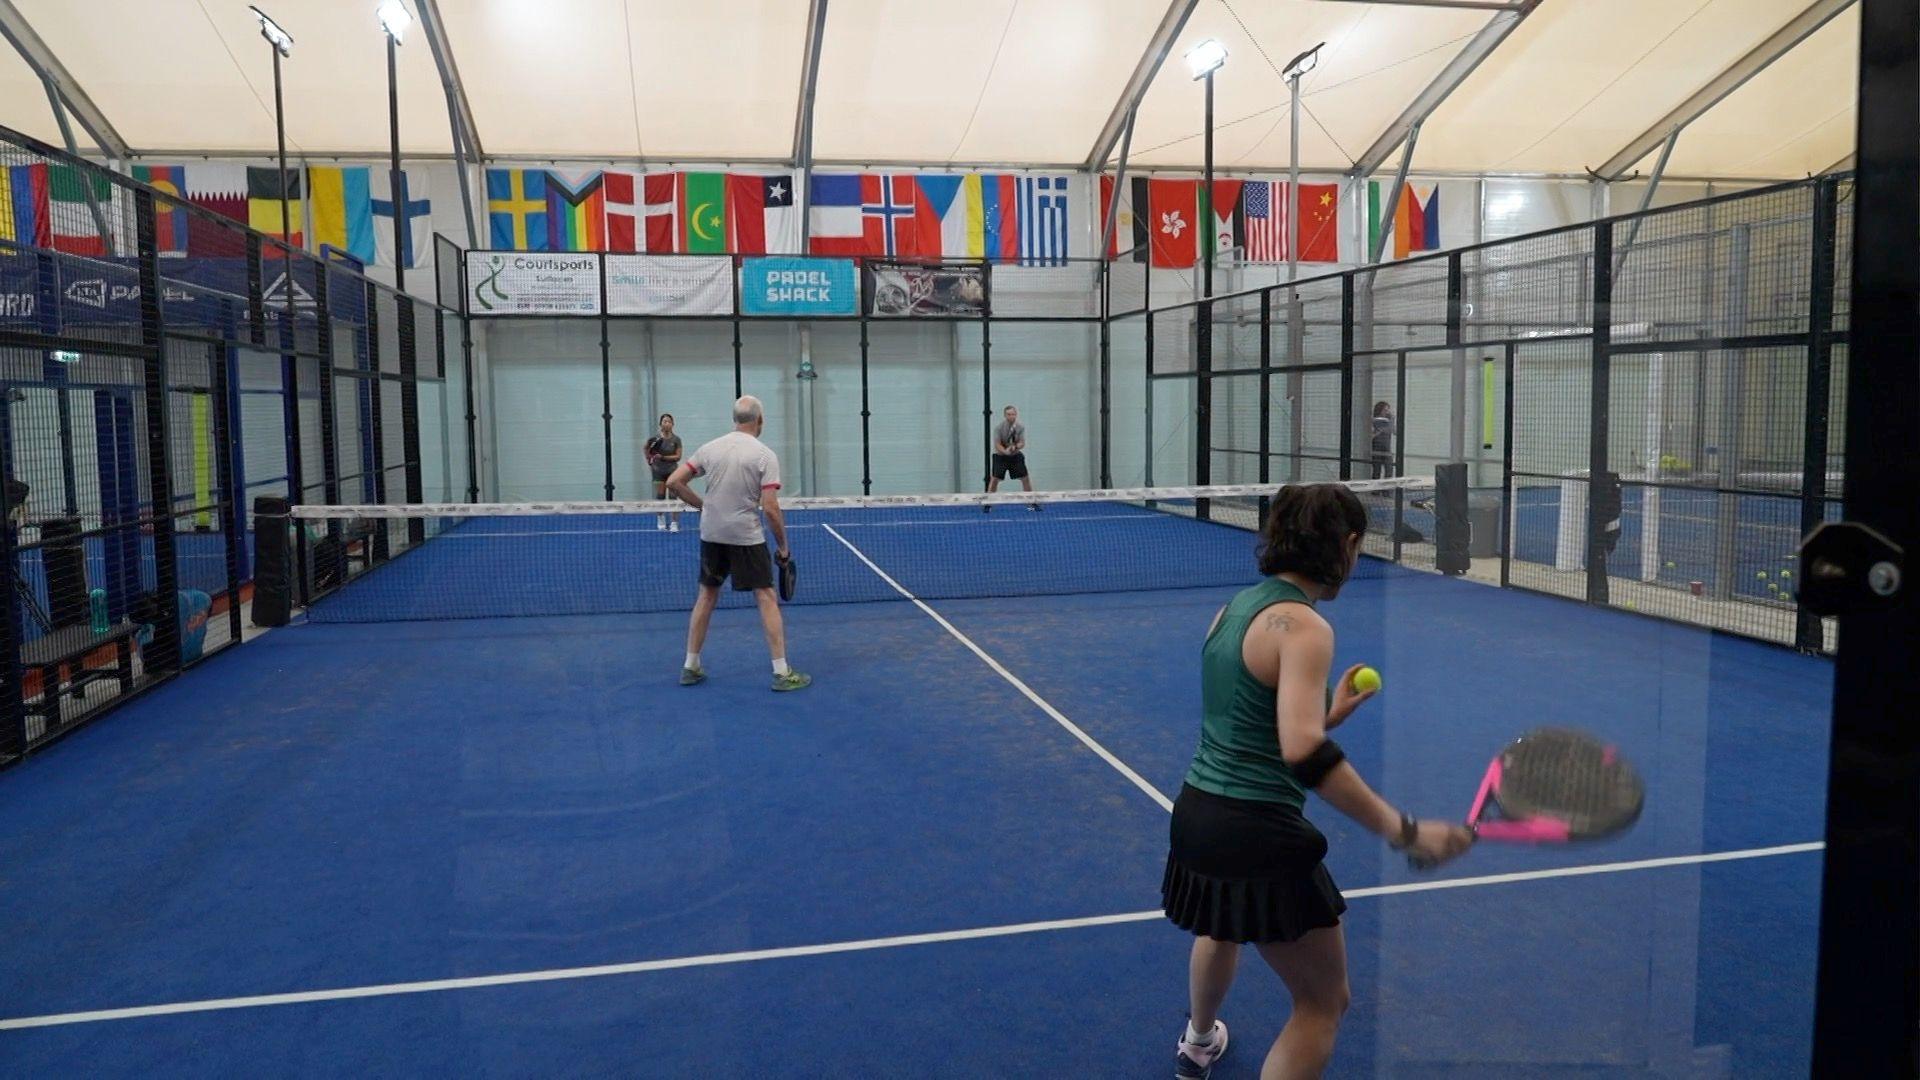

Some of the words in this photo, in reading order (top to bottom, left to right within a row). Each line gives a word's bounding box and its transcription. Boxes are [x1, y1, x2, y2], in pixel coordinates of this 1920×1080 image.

[514, 257, 594, 272] Courtsports
[766, 271, 832, 285] PADEL
[766, 287, 832, 302] SHACK
